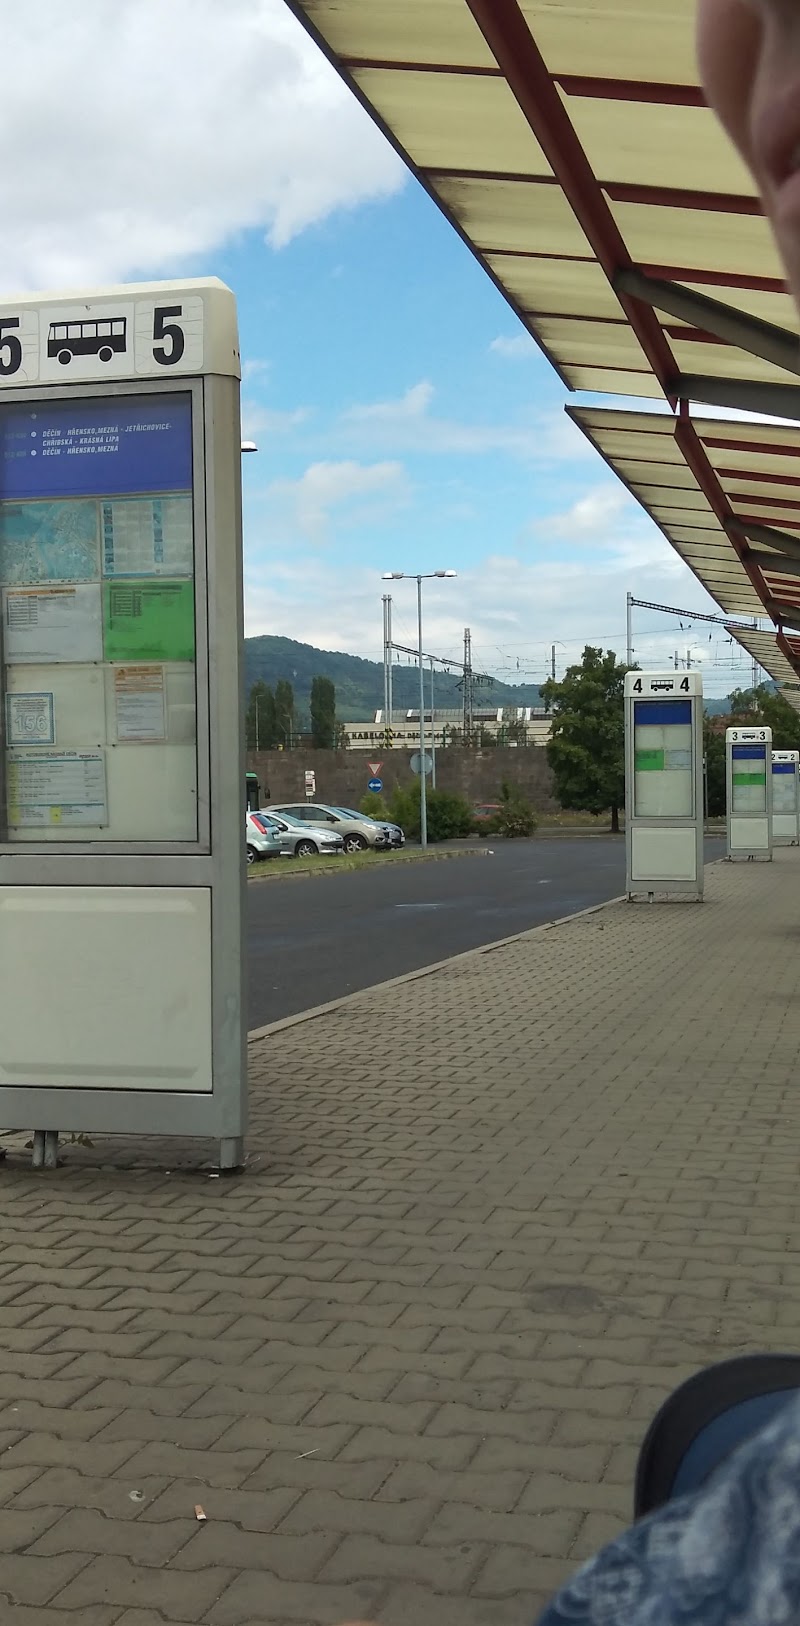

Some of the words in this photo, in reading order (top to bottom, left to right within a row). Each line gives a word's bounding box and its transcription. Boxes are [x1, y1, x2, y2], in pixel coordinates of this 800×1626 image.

[0, 317, 22, 375] 5
[152, 305, 185, 366] 5
[633, 678, 643, 694] 4
[679, 677, 690, 692] 4
[15, 714, 48, 732] 156
[732, 731, 738, 741] 3
[759, 731, 766, 741] 3
[771, 753, 776, 761] 2
[790, 753, 795, 761] 2
